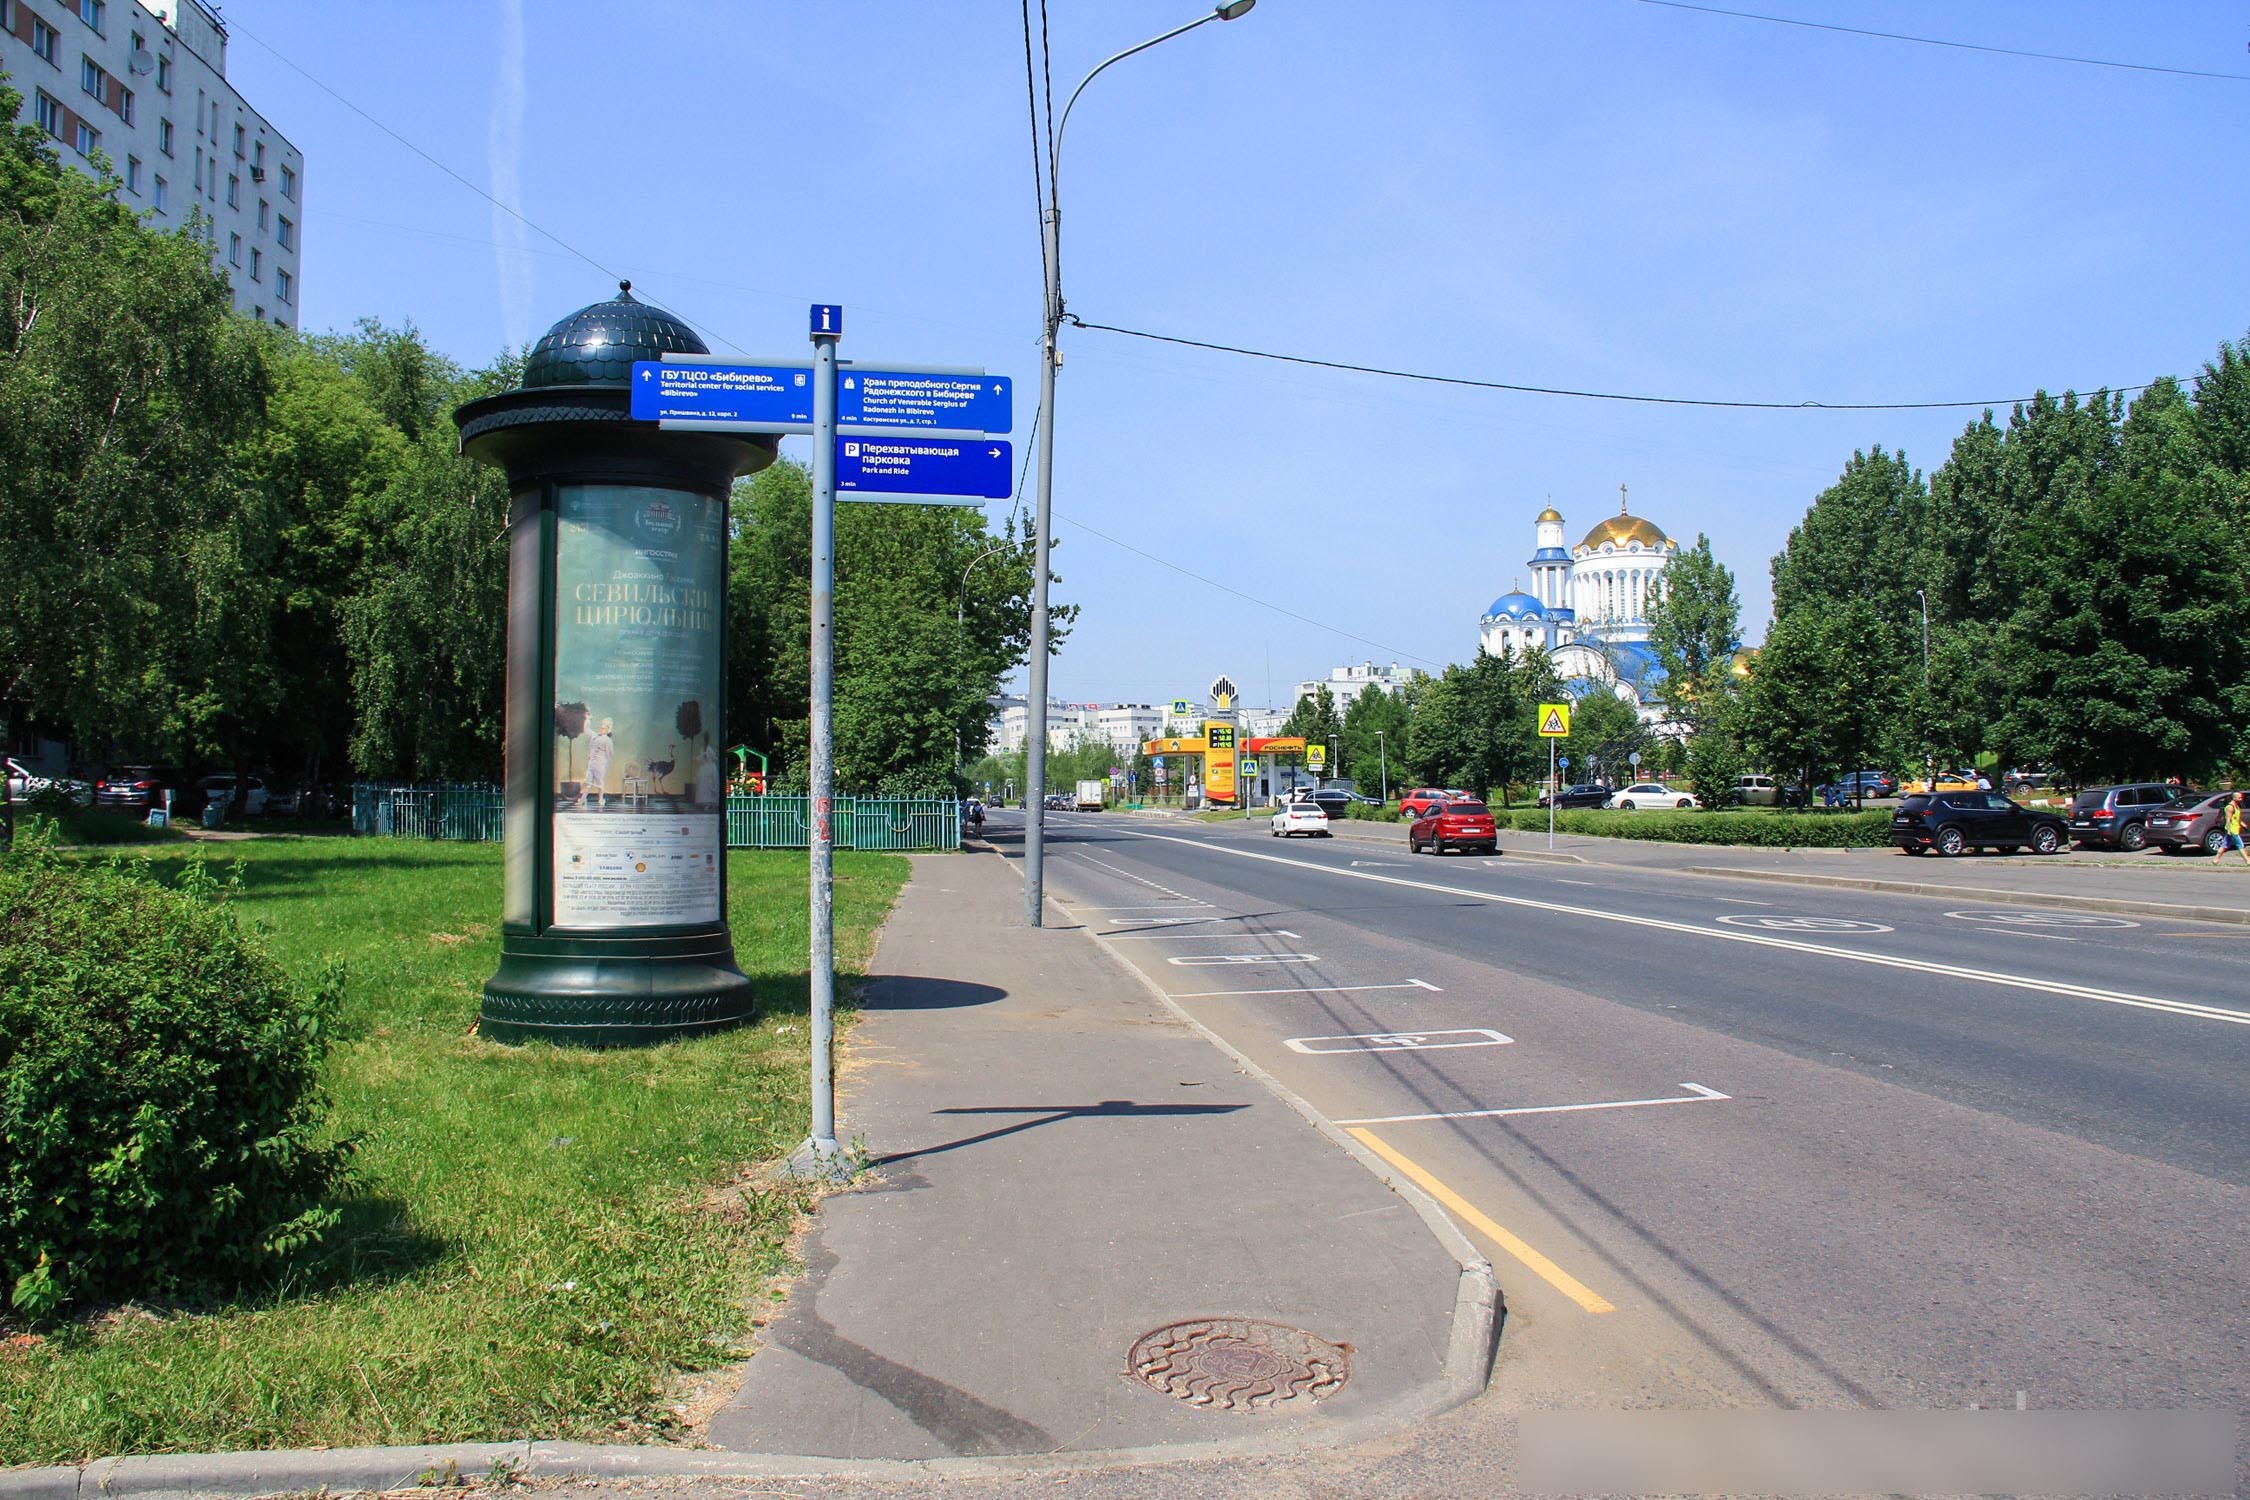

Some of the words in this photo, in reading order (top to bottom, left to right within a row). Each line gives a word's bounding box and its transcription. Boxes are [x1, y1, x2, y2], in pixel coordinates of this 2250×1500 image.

[662, 370, 679, 379] ГБУ
[680, 371, 708, 382] ТЦСО
[710, 372, 773, 384] «Бибирево»
[864, 378, 886, 387] Храм
[888, 380, 950, 389] преподобного
[951, 382, 980, 391] Сергия
[864, 387, 924, 397] Радонежского
[933, 390, 974, 400] Бибиреве
[863, 444, 959, 457] Перехватывающая
[863, 456, 910, 465] парковка
